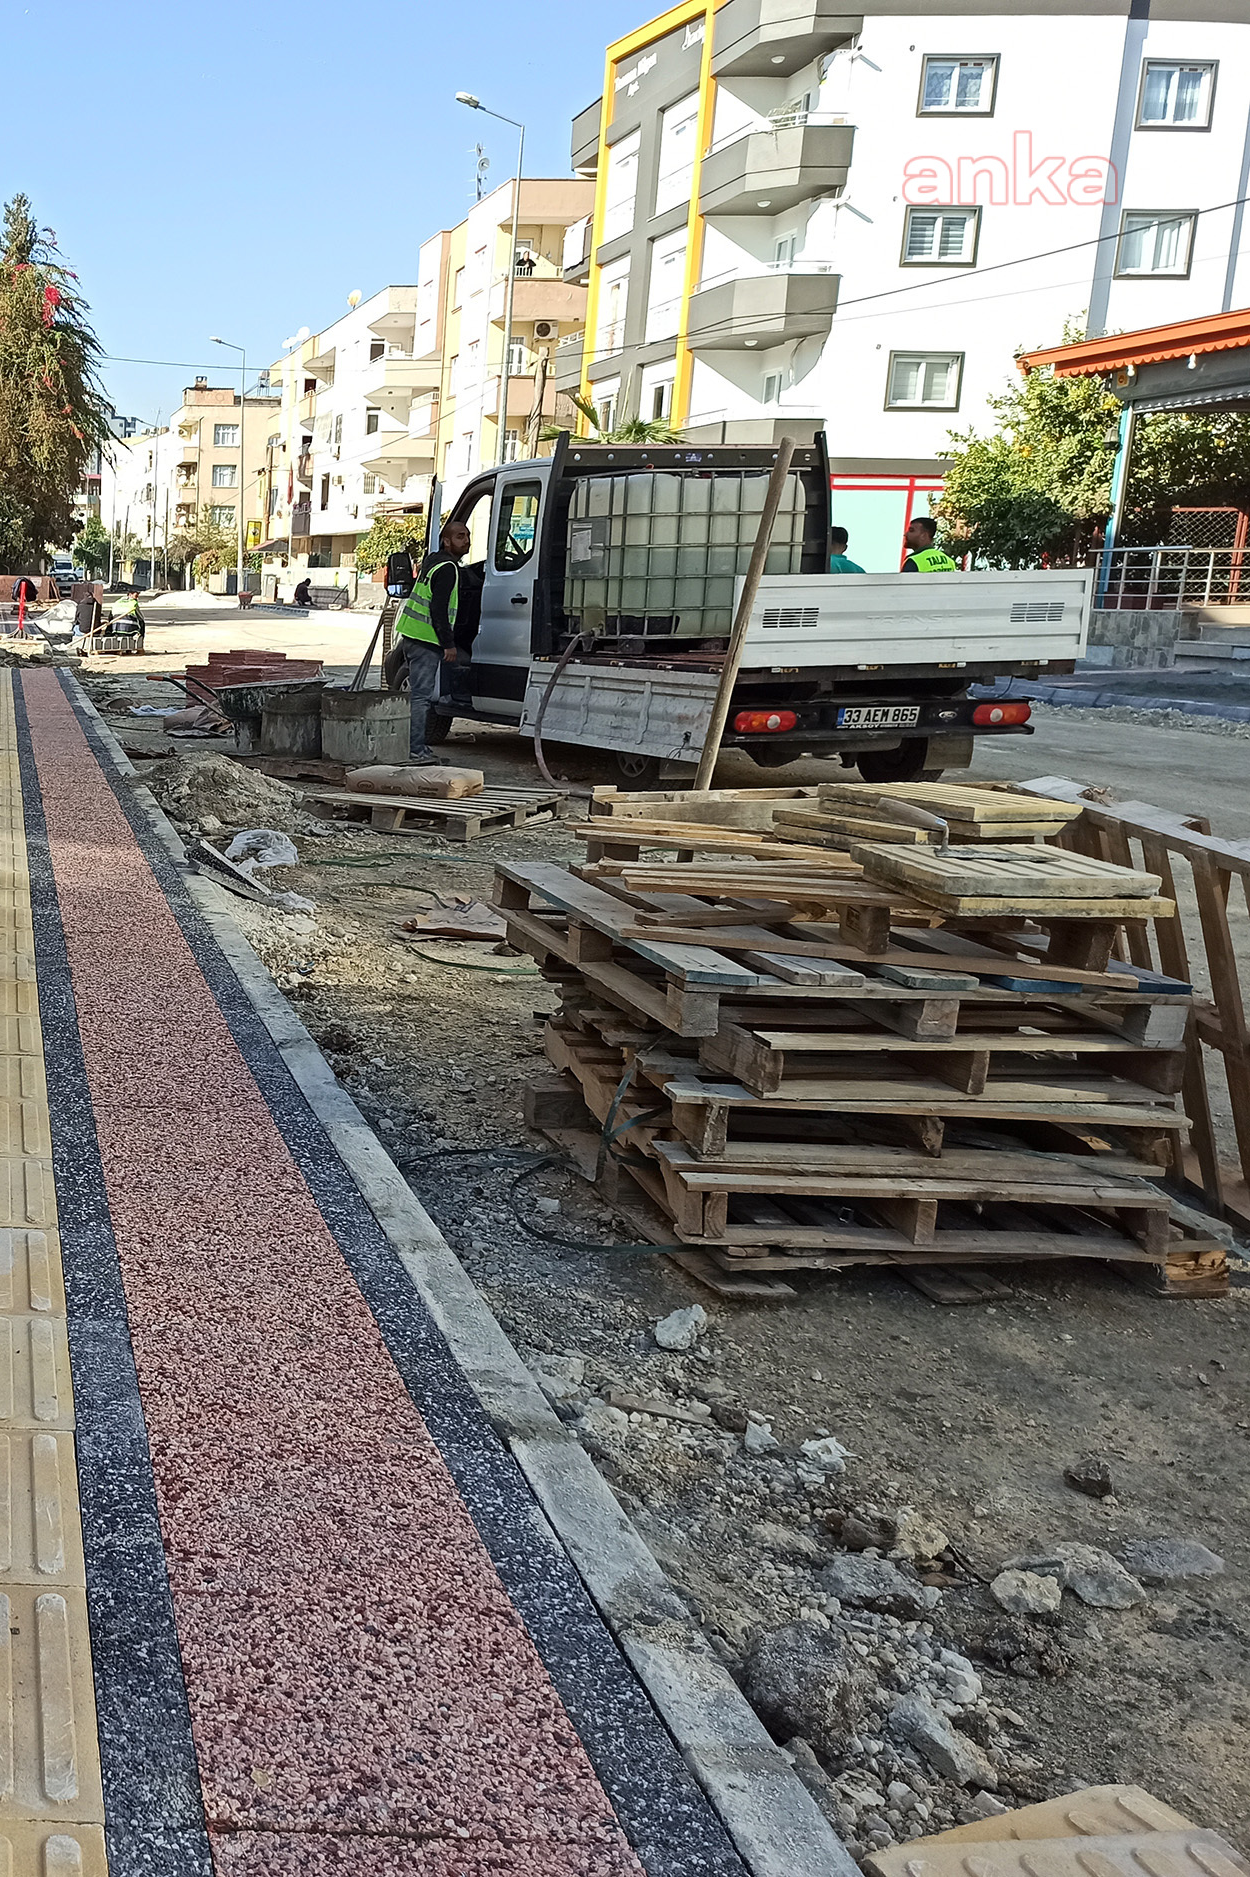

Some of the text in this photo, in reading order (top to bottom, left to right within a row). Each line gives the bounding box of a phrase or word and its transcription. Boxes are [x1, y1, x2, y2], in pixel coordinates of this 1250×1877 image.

[843, 707, 918, 723] 33 AEM 865
